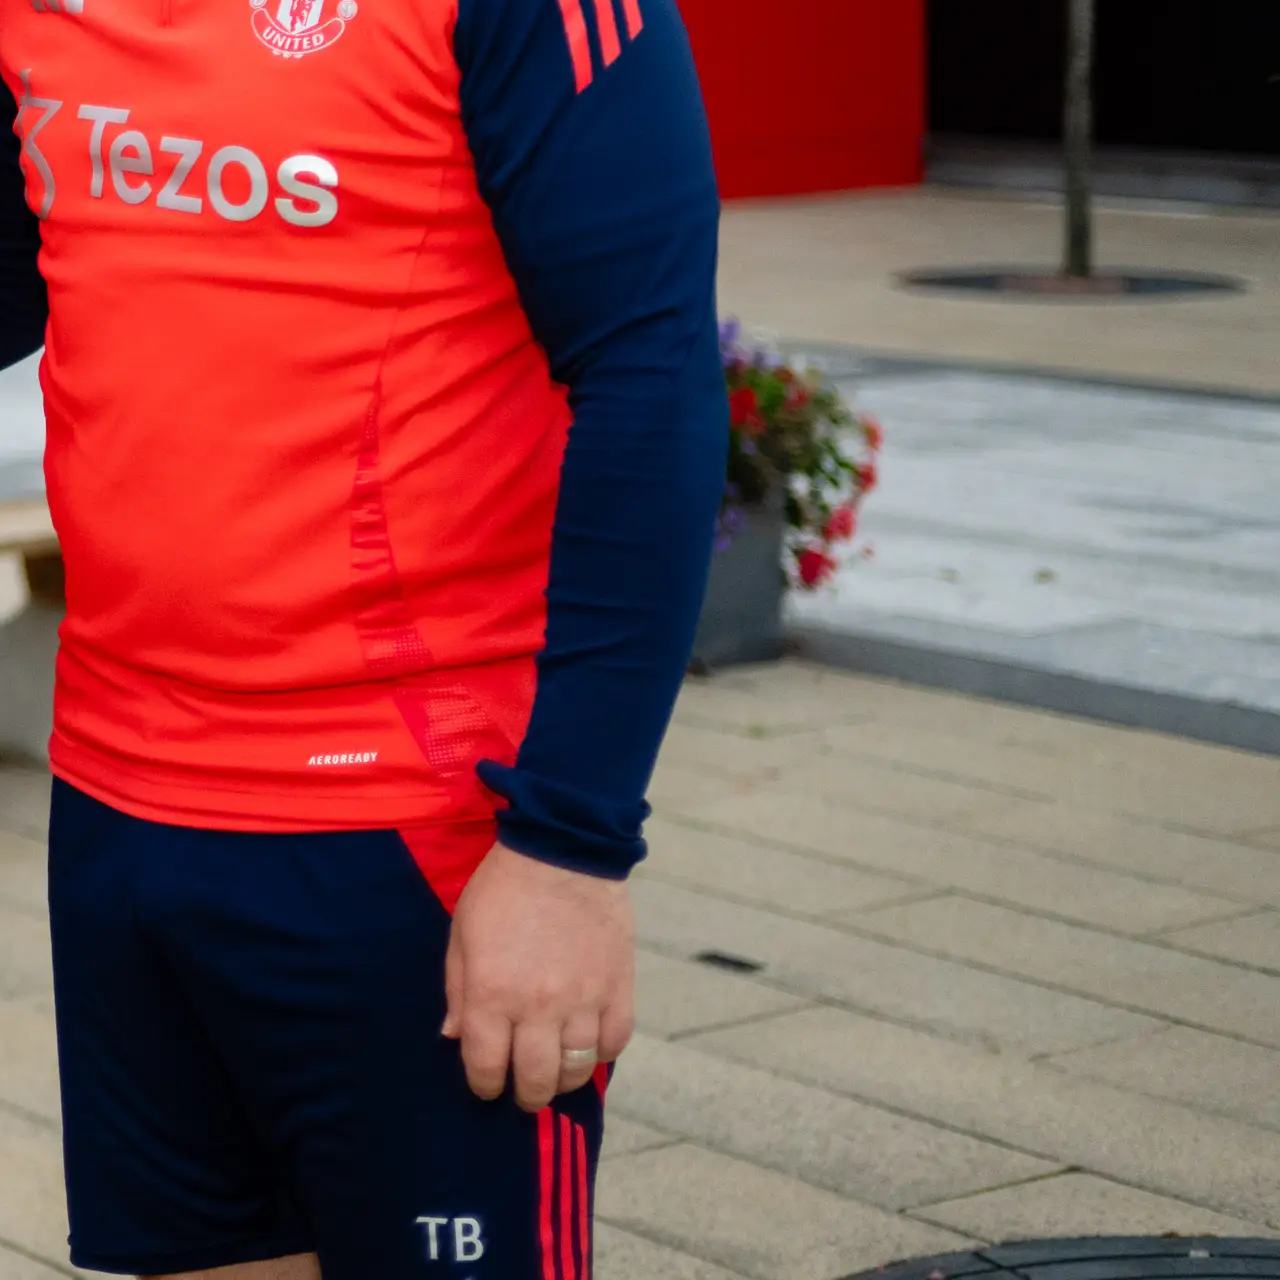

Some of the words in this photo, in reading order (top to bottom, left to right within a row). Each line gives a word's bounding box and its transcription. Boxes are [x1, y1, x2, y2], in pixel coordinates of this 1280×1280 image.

[262, 26, 325, 50] UNITED
[77, 104, 339, 227] Tezos
[308, 751, 378, 766] AEROREADY
[416, 1216, 484, 1261] TB
